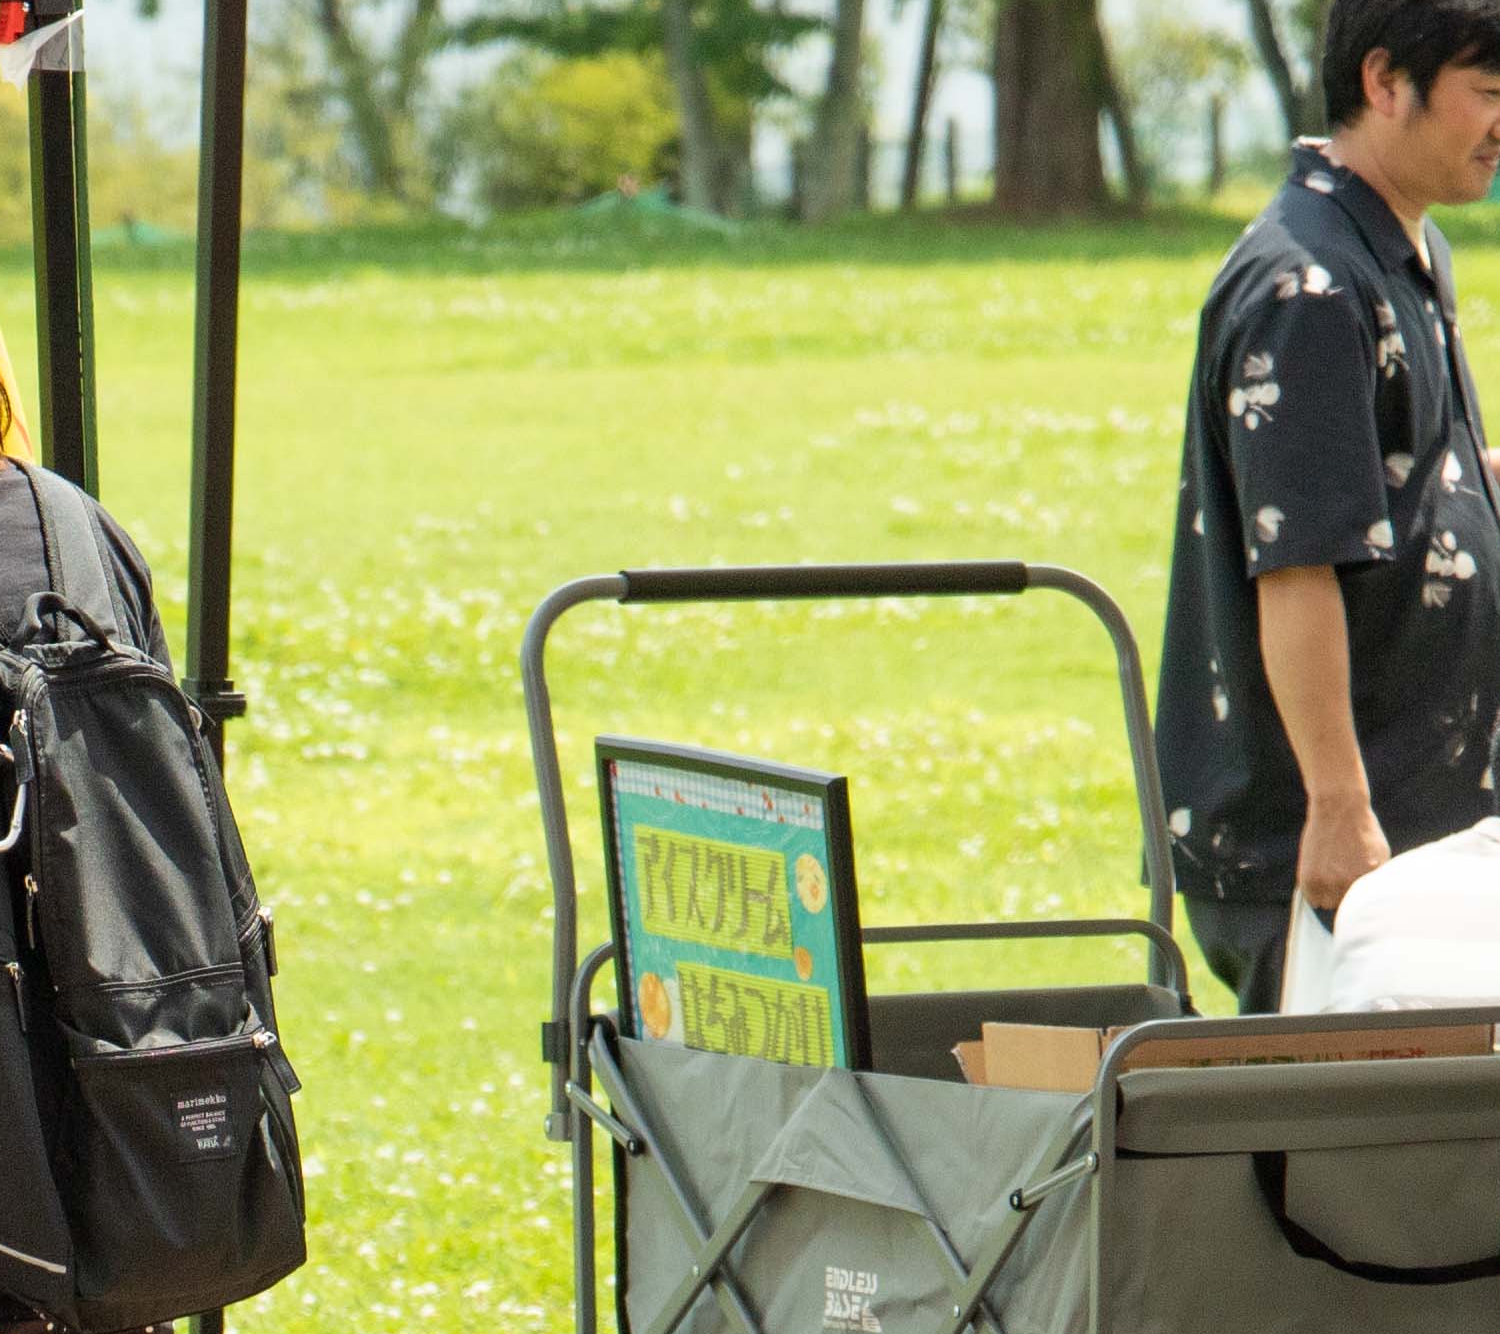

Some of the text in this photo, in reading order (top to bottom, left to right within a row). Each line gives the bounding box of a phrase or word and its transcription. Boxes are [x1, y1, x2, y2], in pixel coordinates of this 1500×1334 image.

[637, 833, 791, 946] アイスクリーム
[177, 1094, 226, 1109] marimekko
